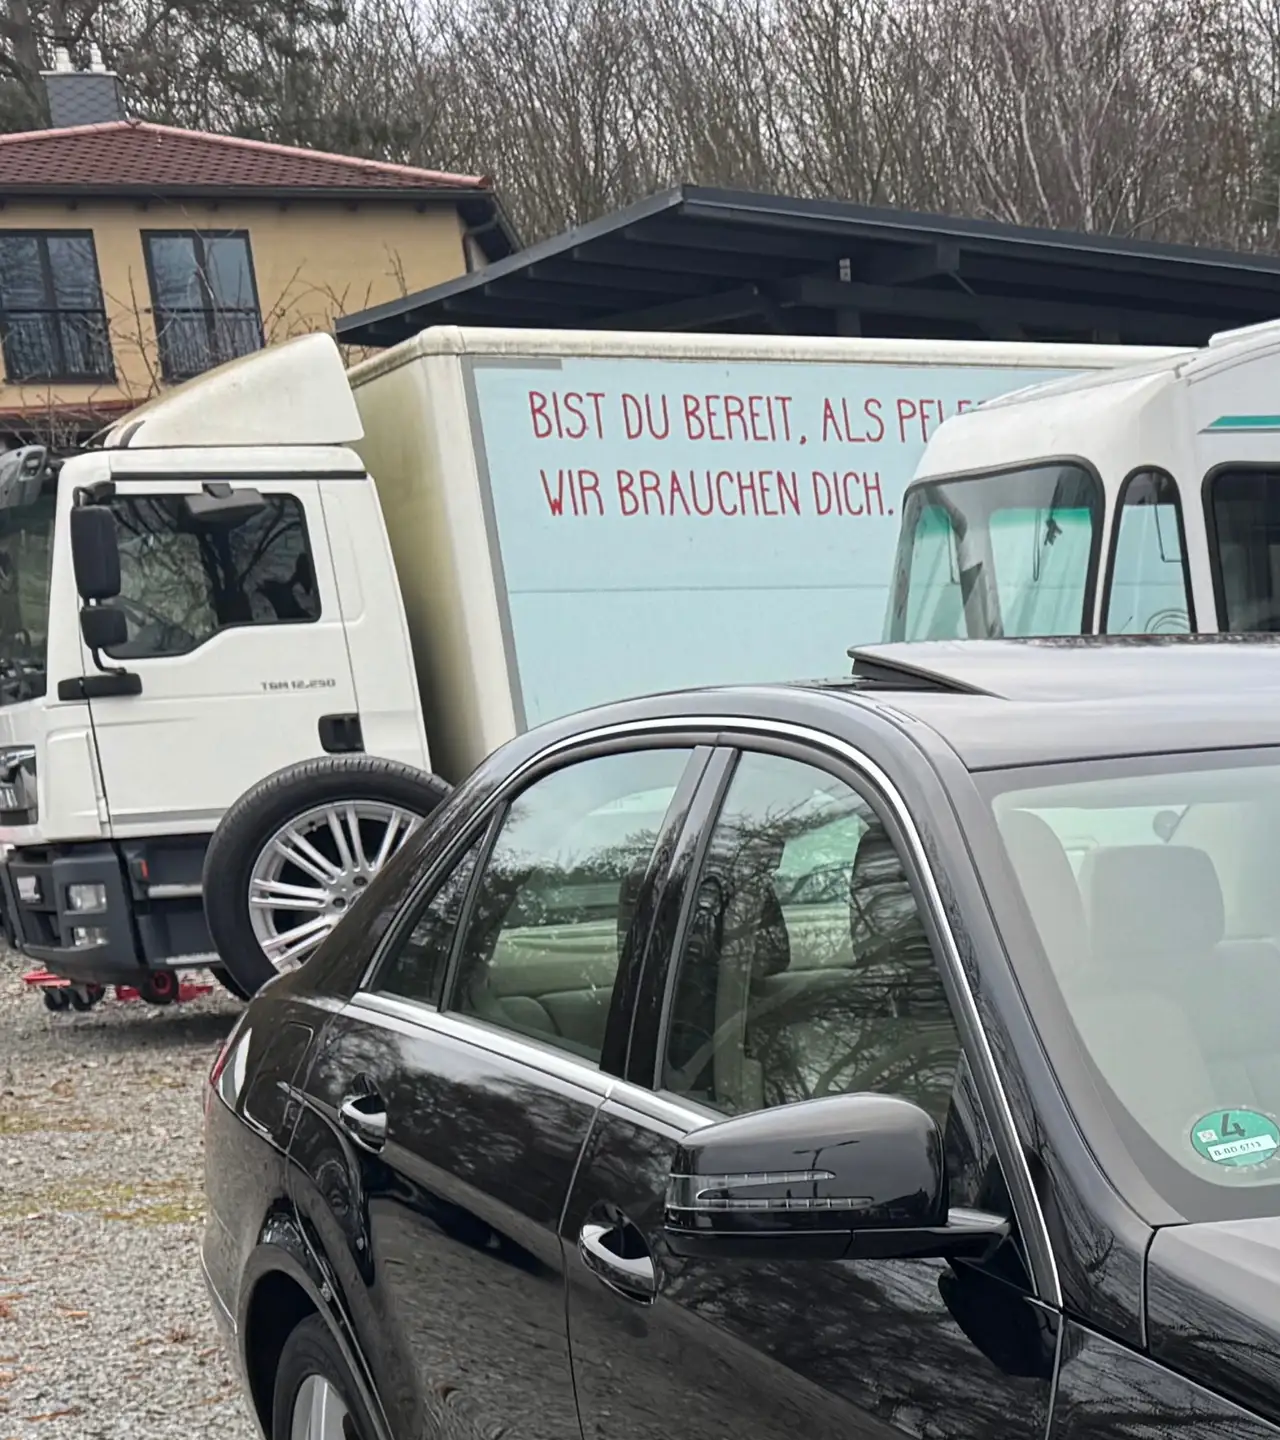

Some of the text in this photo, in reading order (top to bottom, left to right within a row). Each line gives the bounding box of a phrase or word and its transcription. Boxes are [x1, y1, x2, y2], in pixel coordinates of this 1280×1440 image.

[528, 391, 605, 440] BIST
[621, 393, 670, 442] DU
[683, 395, 808, 445] BEREIT,
[822, 397, 884, 443] ALS
[540, 469, 894, 517] WIR BRAUCHEN DICH.
[1221, 1113, 1246, 1138] 4
